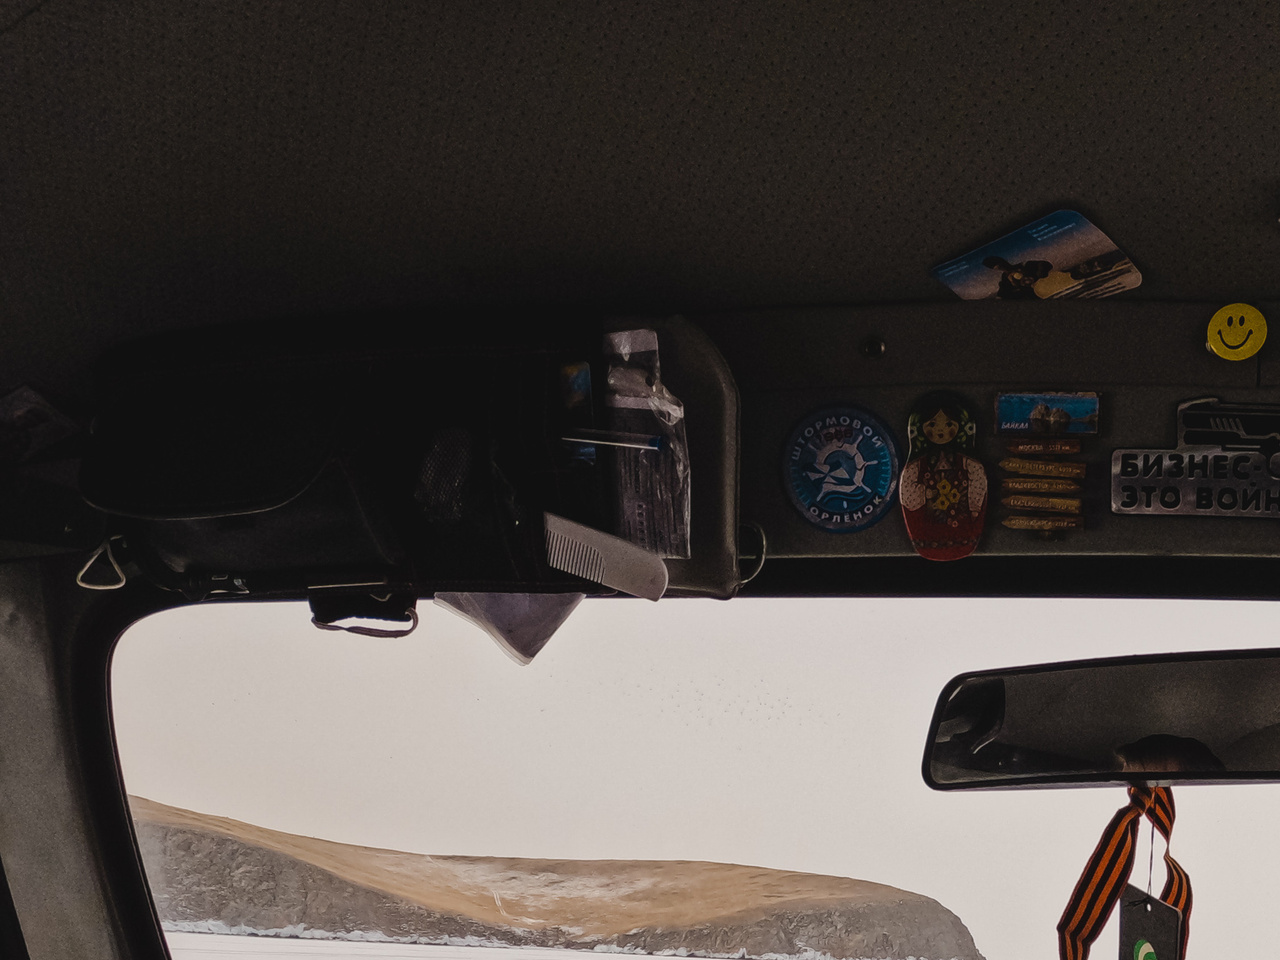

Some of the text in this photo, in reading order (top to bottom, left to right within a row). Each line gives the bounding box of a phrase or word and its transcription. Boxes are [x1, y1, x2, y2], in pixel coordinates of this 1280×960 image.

[1001, 421, 1029, 429] БАЙКАЛ
[791, 416, 885, 461] ШТОРМОВОЙ
[810, 495, 882, 523] ОРЛЁНОК
[1121, 485, 1181, 509] ЭТО
